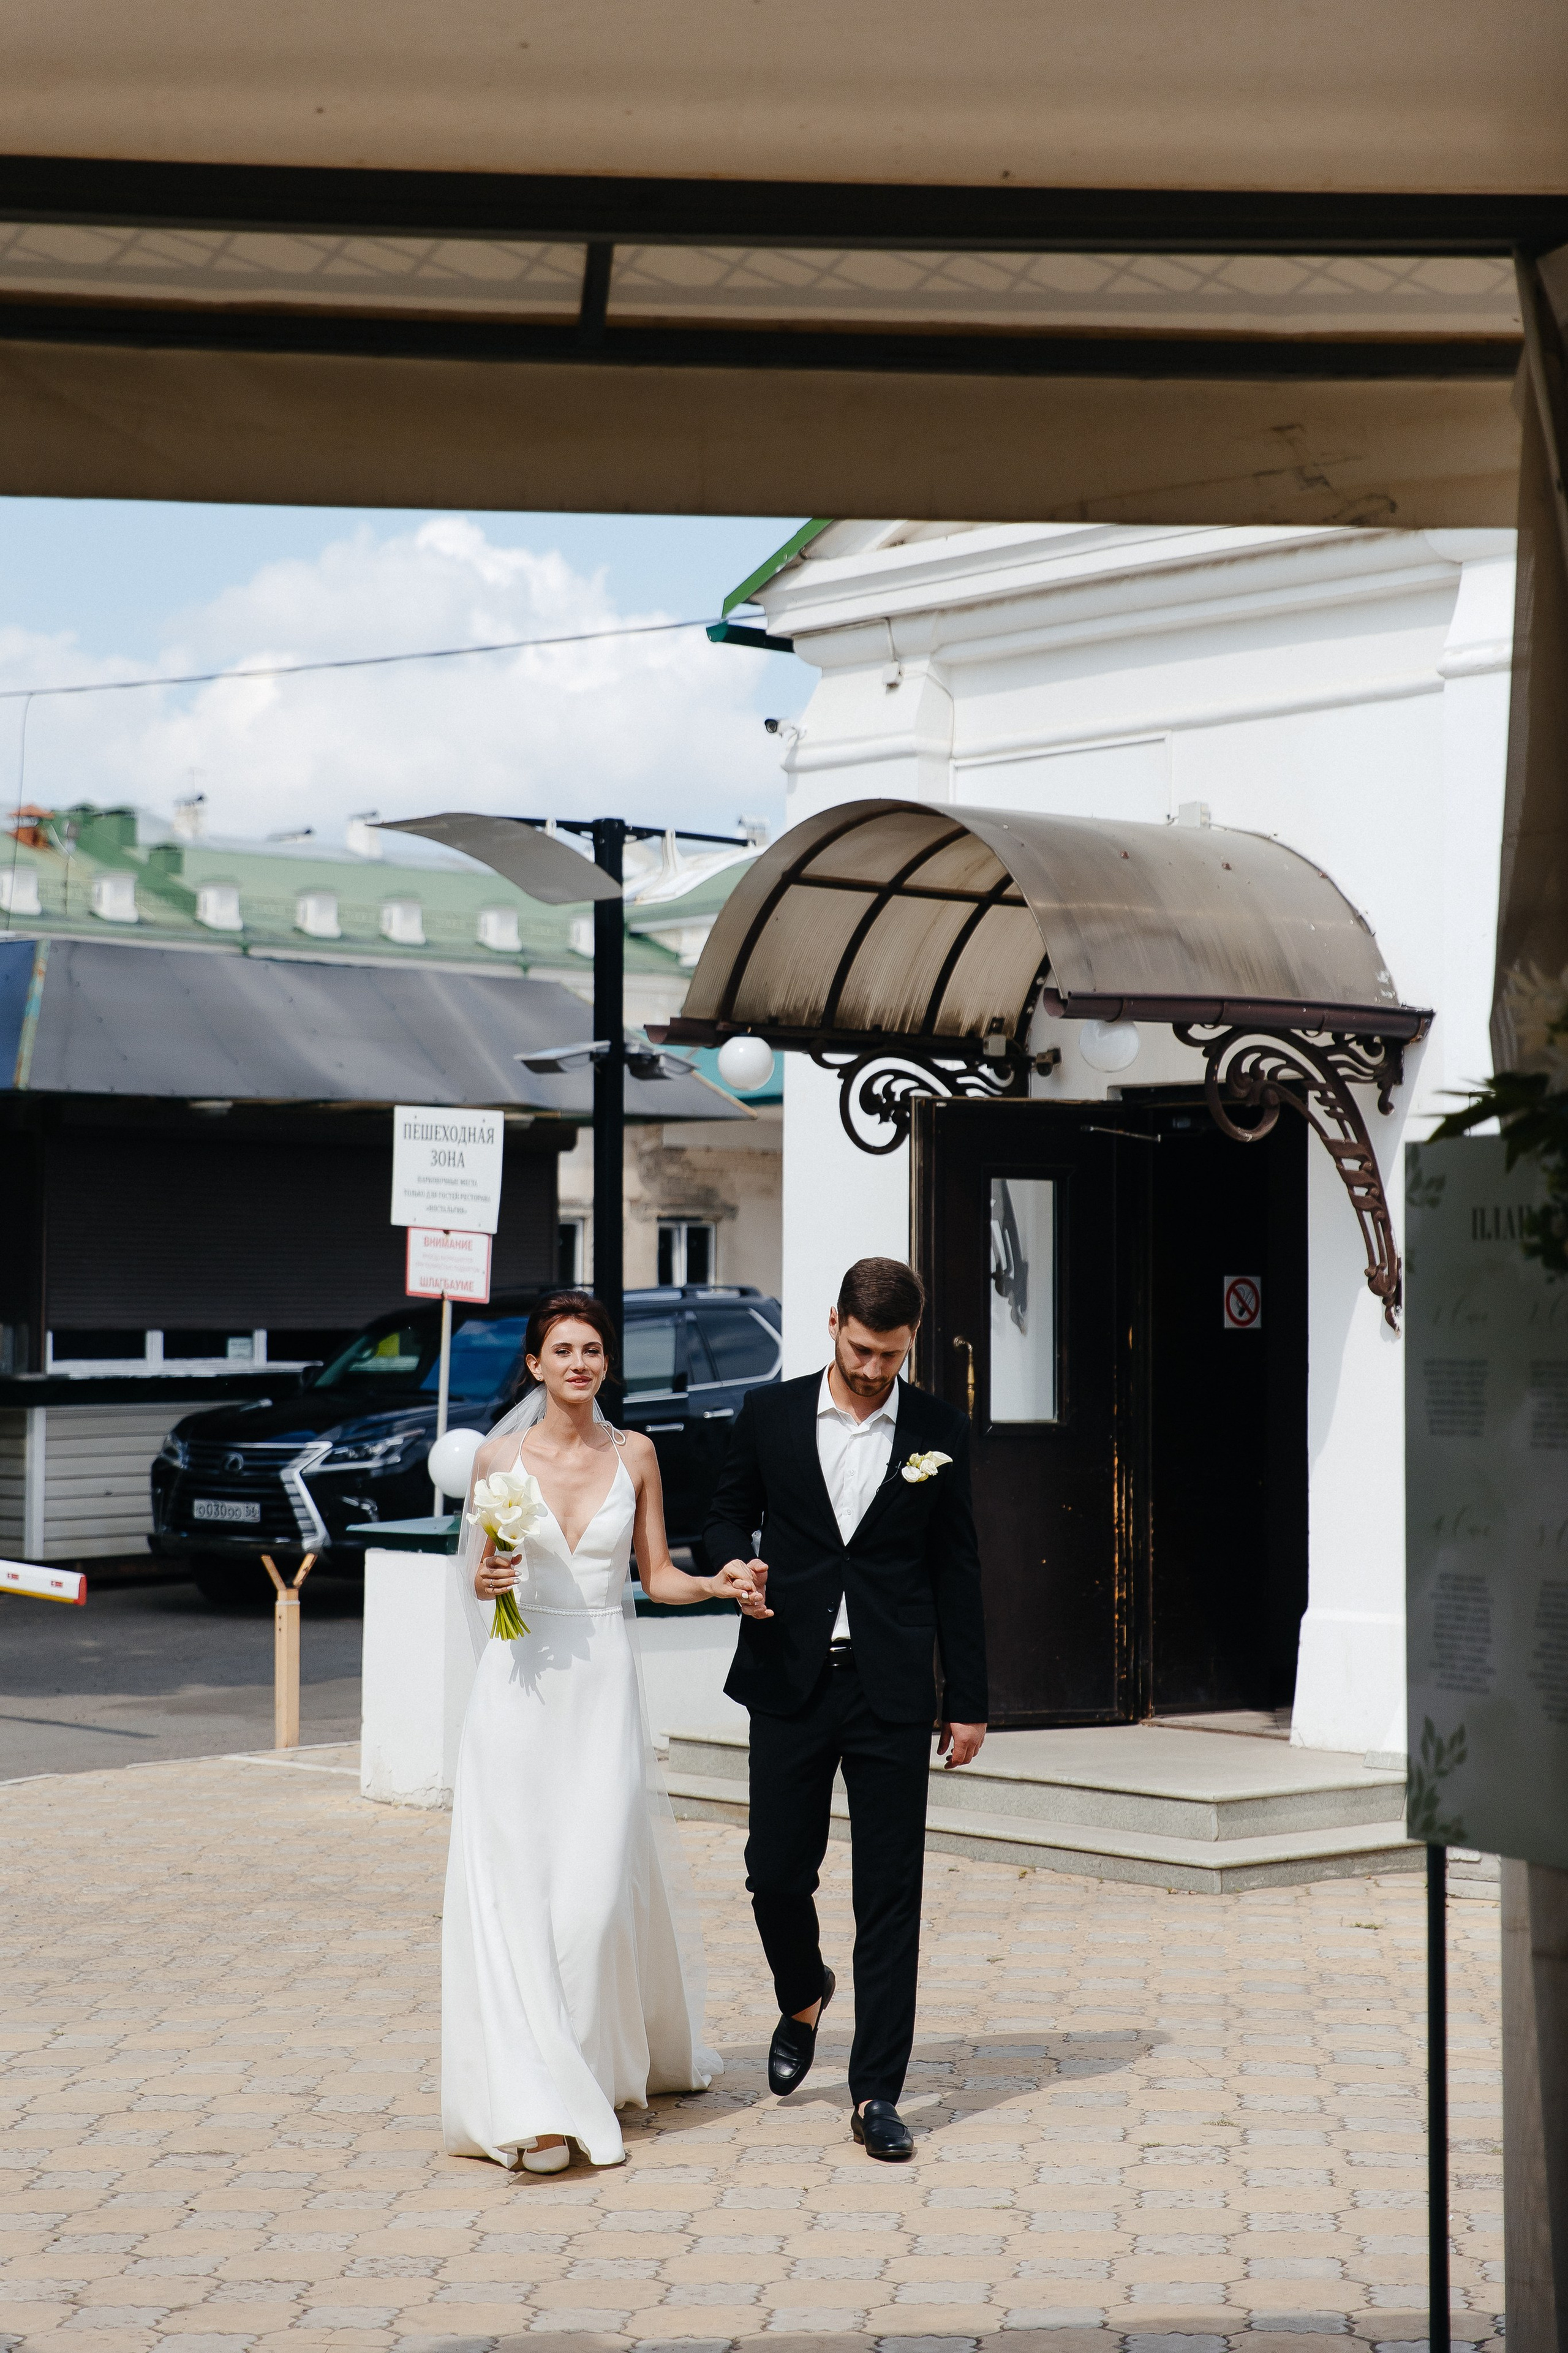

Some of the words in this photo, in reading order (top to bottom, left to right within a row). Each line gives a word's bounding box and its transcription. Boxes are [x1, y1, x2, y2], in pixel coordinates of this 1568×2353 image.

[403, 1122, 494, 1146] ПЕШЕХОДНАЯ
[431, 1150, 465, 1168] ЗОНА
[424, 1236, 473, 1251] ВНИМАНИЕ
[420, 1276, 474, 1291] ШЛАГБАУМЕ
